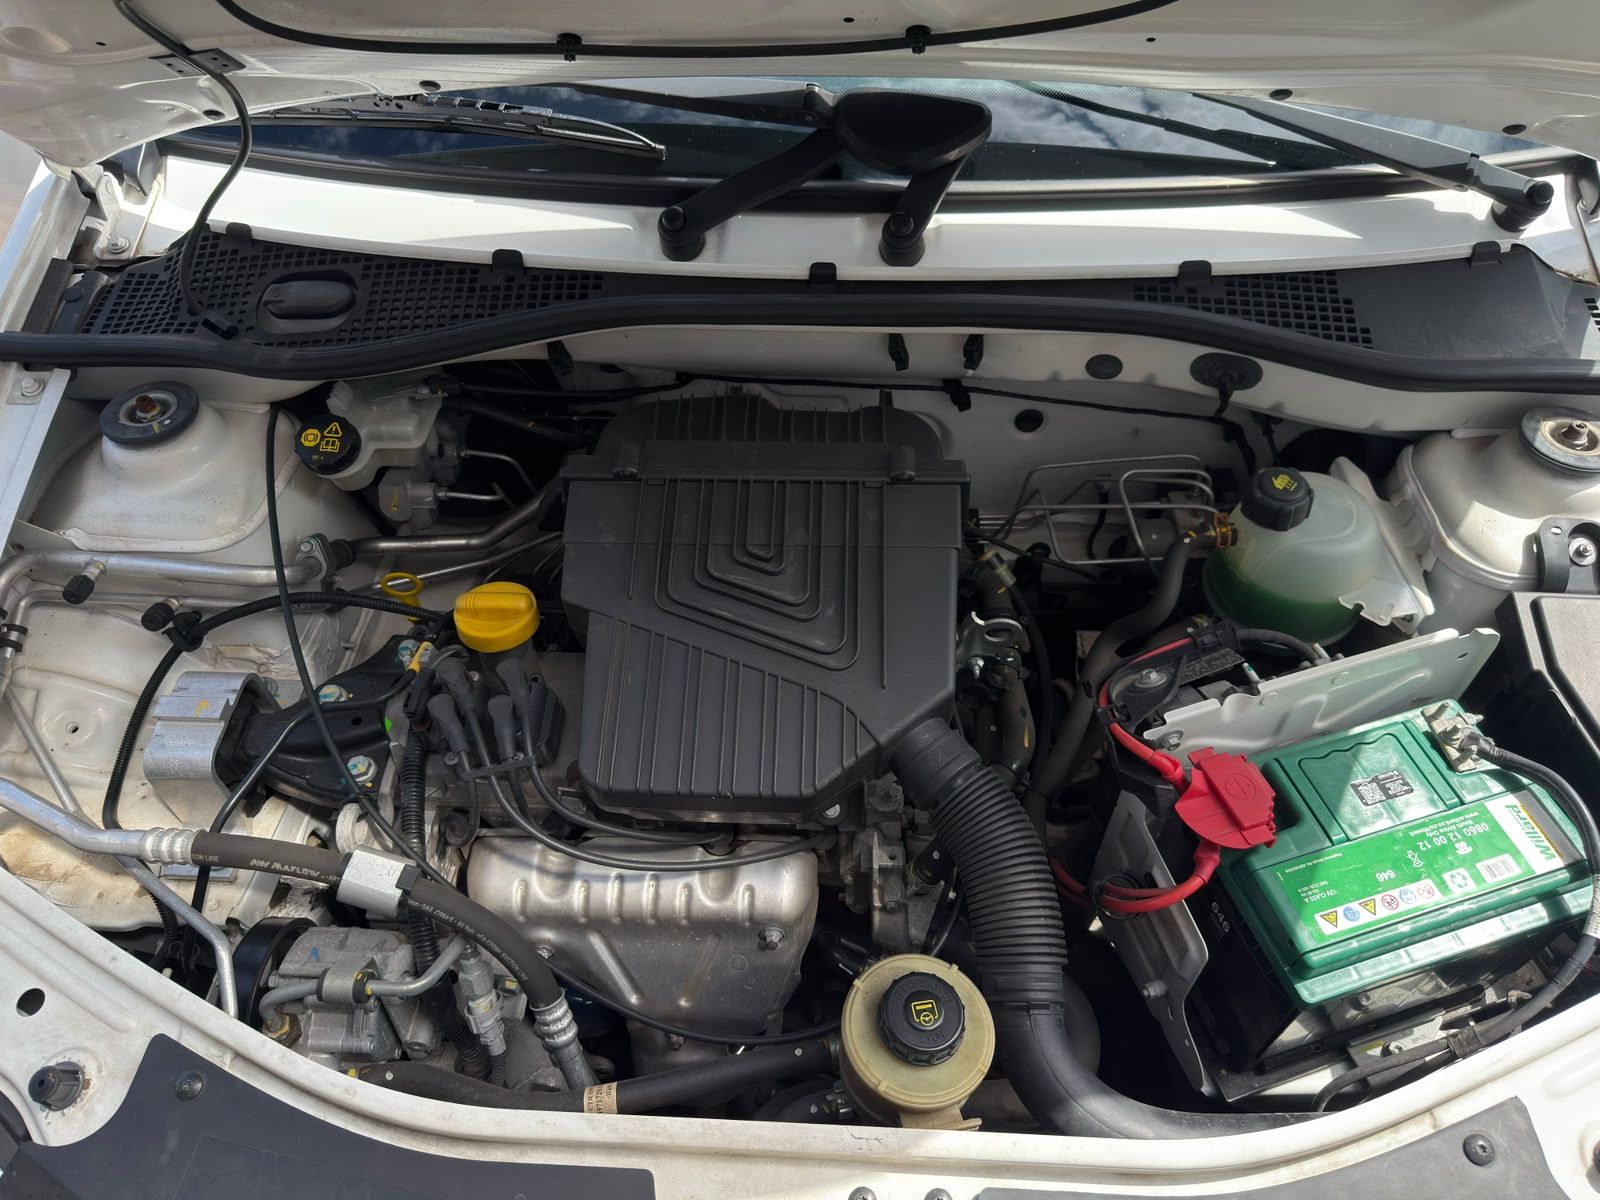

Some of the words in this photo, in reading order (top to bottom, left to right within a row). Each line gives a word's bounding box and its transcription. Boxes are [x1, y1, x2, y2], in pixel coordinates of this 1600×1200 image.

[1463, 822, 1489, 836] 0860
[1504, 804, 1557, 861] Willard
[1433, 835, 1447, 846] 00
[1448, 831, 1462, 841] 12
[1417, 840, 1432, 851] 12
[271, 862, 320, 877] MAFLOW
[1376, 869, 1395, 882] 646
